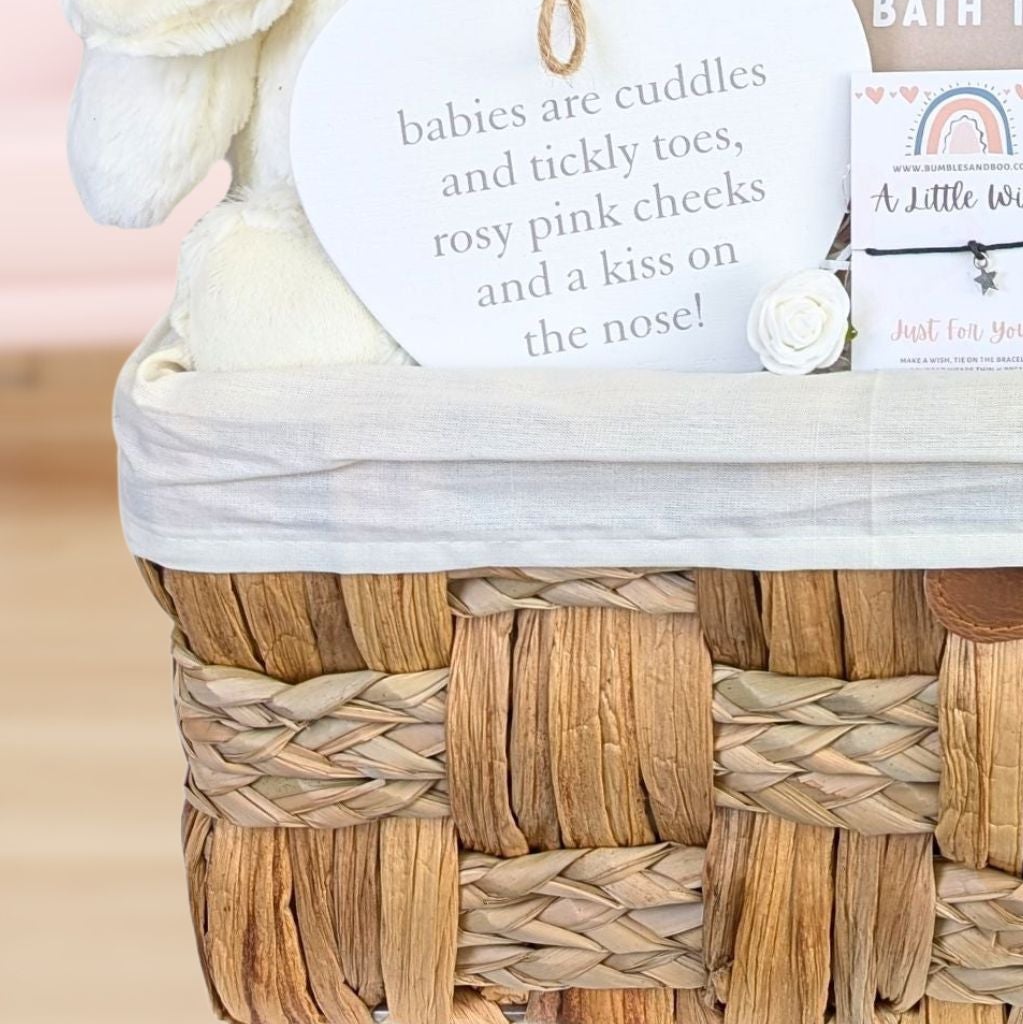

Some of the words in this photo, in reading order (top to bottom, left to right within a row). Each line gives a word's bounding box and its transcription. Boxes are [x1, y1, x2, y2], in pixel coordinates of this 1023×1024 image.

[397, 97, 527, 146] babies
[541, 90, 602, 123] are
[614, 56, 767, 109] cuddles
[441, 150, 517, 197] and
[529, 133, 640, 181] tickly
[653, 126, 744, 161] toes,
[433, 222, 514, 259] rosy
[528, 192, 622, 252] pink
[633, 170, 767, 222] cheeks
[870, 182, 900, 213] A
[905, 180, 978, 213] Little
[477, 260, 553, 308] and
[567, 267, 589, 293] a
[600, 246, 675, 286] kiss
[687, 240, 739, 271] on
[524, 318, 589, 358] the
[602, 292, 705, 345] nose!
[891, 318, 941, 342] Just
[900, 356, 921, 364] MAKE
[954, 356, 965, 364] TIE
[967, 356, 978, 364] ON
[980, 356, 995, 364] THE
